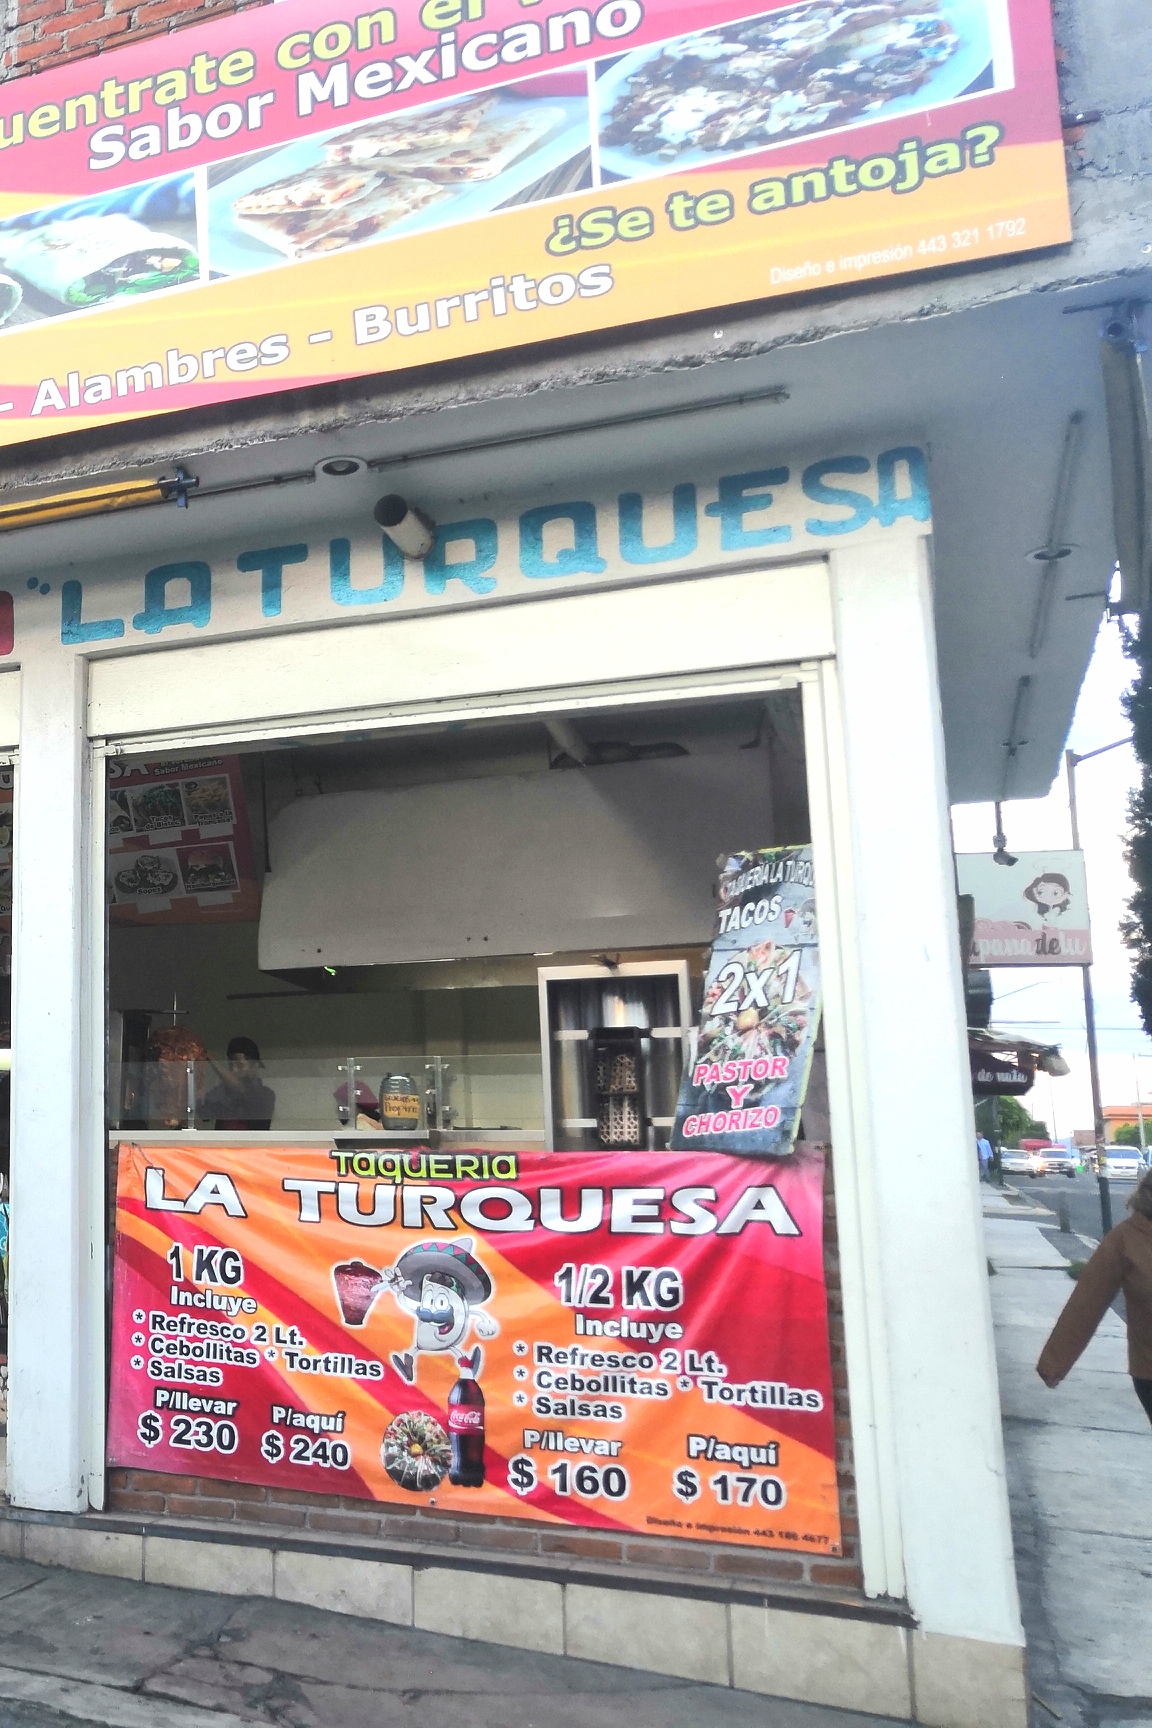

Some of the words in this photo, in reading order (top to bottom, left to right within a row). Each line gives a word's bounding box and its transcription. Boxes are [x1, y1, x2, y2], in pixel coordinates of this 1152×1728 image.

[272, 4, 398, 72] con
[87, 86, 279, 172] Sabor
[296, 0, 644, 118] Mexicano
[544, 203, 656, 259] ¿Se
[666, 187, 735, 234] te
[749, 120, 1008, 217] antoja?
[769, 260, 823, 286] Diseño
[825, 261, 835, 275] e
[838, 242, 914, 273] impresión
[917, 234, 948, 257] 443
[951, 229, 980, 249] 321
[986, 217, 1027, 242] 1792
[29, 331, 292, 418] Alambres
[353, 262, 617, 348] Burritos
[235, 445, 932, 619] TURQUESA
[718, 894, 783, 935] TACOS
[692, 1056, 790, 1087] PASTOR
[726, 1083, 754, 1109] Y
[682, 1105, 782, 1138] CHORIZO
[145, 1166, 248, 1219] LA
[282, 1177, 804, 1238] TURQUESA
[167, 1244, 183, 1283] 1
[194, 1247, 244, 1287] KG
[169, 1285, 258, 1318] Incluye
[554, 1262, 614, 1308] 1/2
[623, 1266, 685, 1312] KG
[150, 1312, 247, 1343] Refresco
[253, 1323, 269, 1345] 2
[274, 1327, 306, 1348] Lt.
[574, 1313, 685, 1345] Incluye
[149, 1336, 259, 1367] Cebollitas
[284, 1350, 383, 1380] Tortillas
[149, 1359, 223, 1385] Salsas
[535, 1343, 656, 1371] Refresco
[662, 1351, 679, 1372] 2
[687, 1352, 727, 1376] Lt.
[155, 1388, 239, 1418] P/llevar
[534, 1369, 670, 1399] Cebollitas
[701, 1380, 823, 1411] Tortillas
[534, 1396, 625, 1421] Salsas
[138, 1412, 163, 1446] $
[172, 1418, 238, 1453] 230
[271, 1405, 347, 1435] P/aquí
[261, 1432, 283, 1463] $
[291, 1437, 351, 1470] 240
[523, 1428, 623, 1459] P/llevar
[686, 1434, 780, 1469] P/aquí
[508, 1457, 536, 1495] $
[551, 1461, 629, 1501] 160
[673, 1470, 701, 1505] $
[712, 1474, 787, 1511] 170
